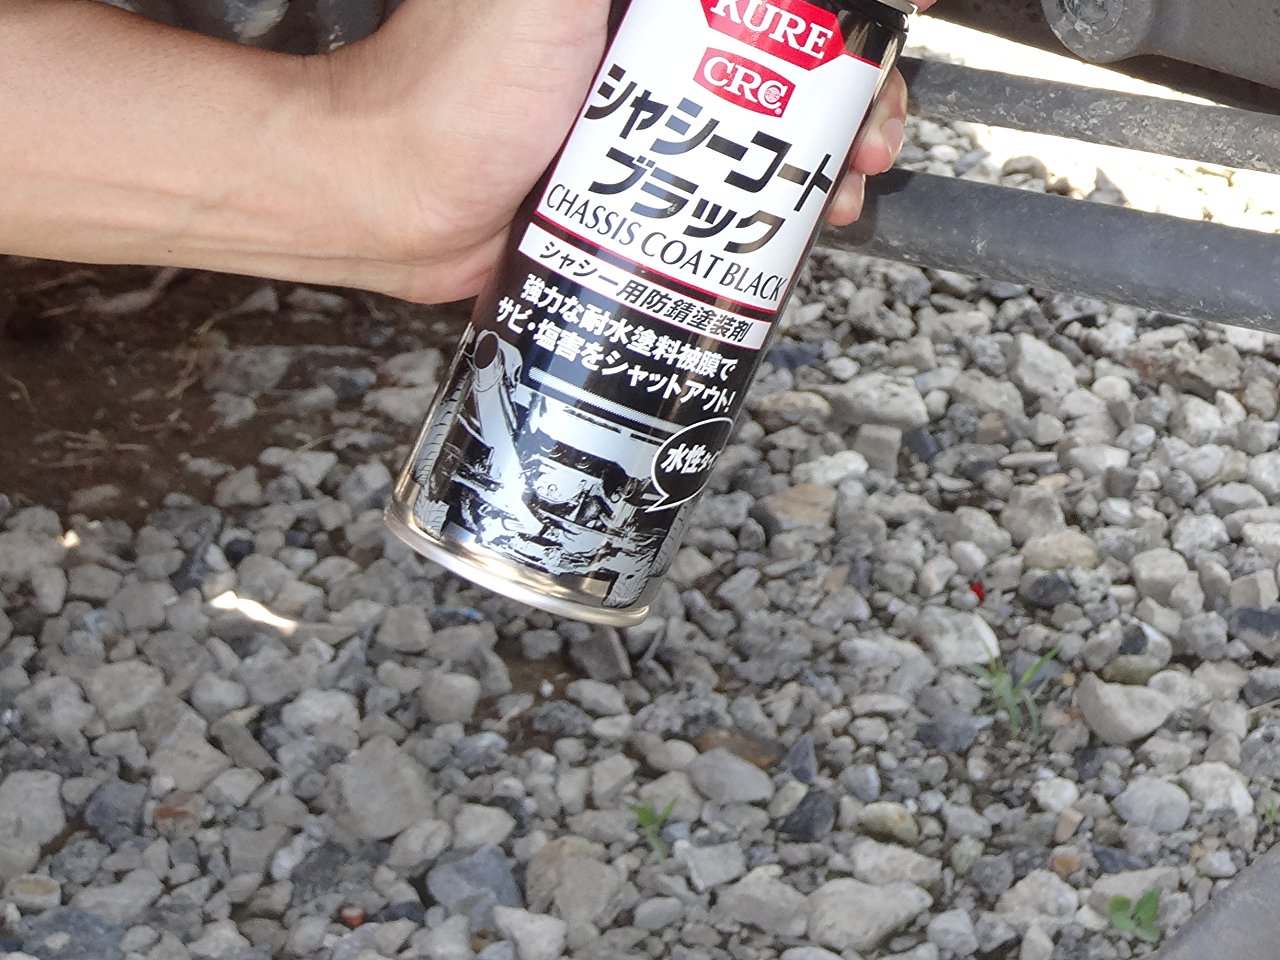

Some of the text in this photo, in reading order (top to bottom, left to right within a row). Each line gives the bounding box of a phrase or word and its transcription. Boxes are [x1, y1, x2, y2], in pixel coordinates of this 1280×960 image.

[703, 56, 789, 110] CRC
[583, 63, 833, 212] シャシーコート
[546, 183, 788, 302] CHASSIS COAT BLACK
[587, 146, 787, 254] ブラック
[520, 273, 740, 382] 強力な耐水塗料被膜で
[539, 241, 753, 343] シャシー用防錆塗装剤
